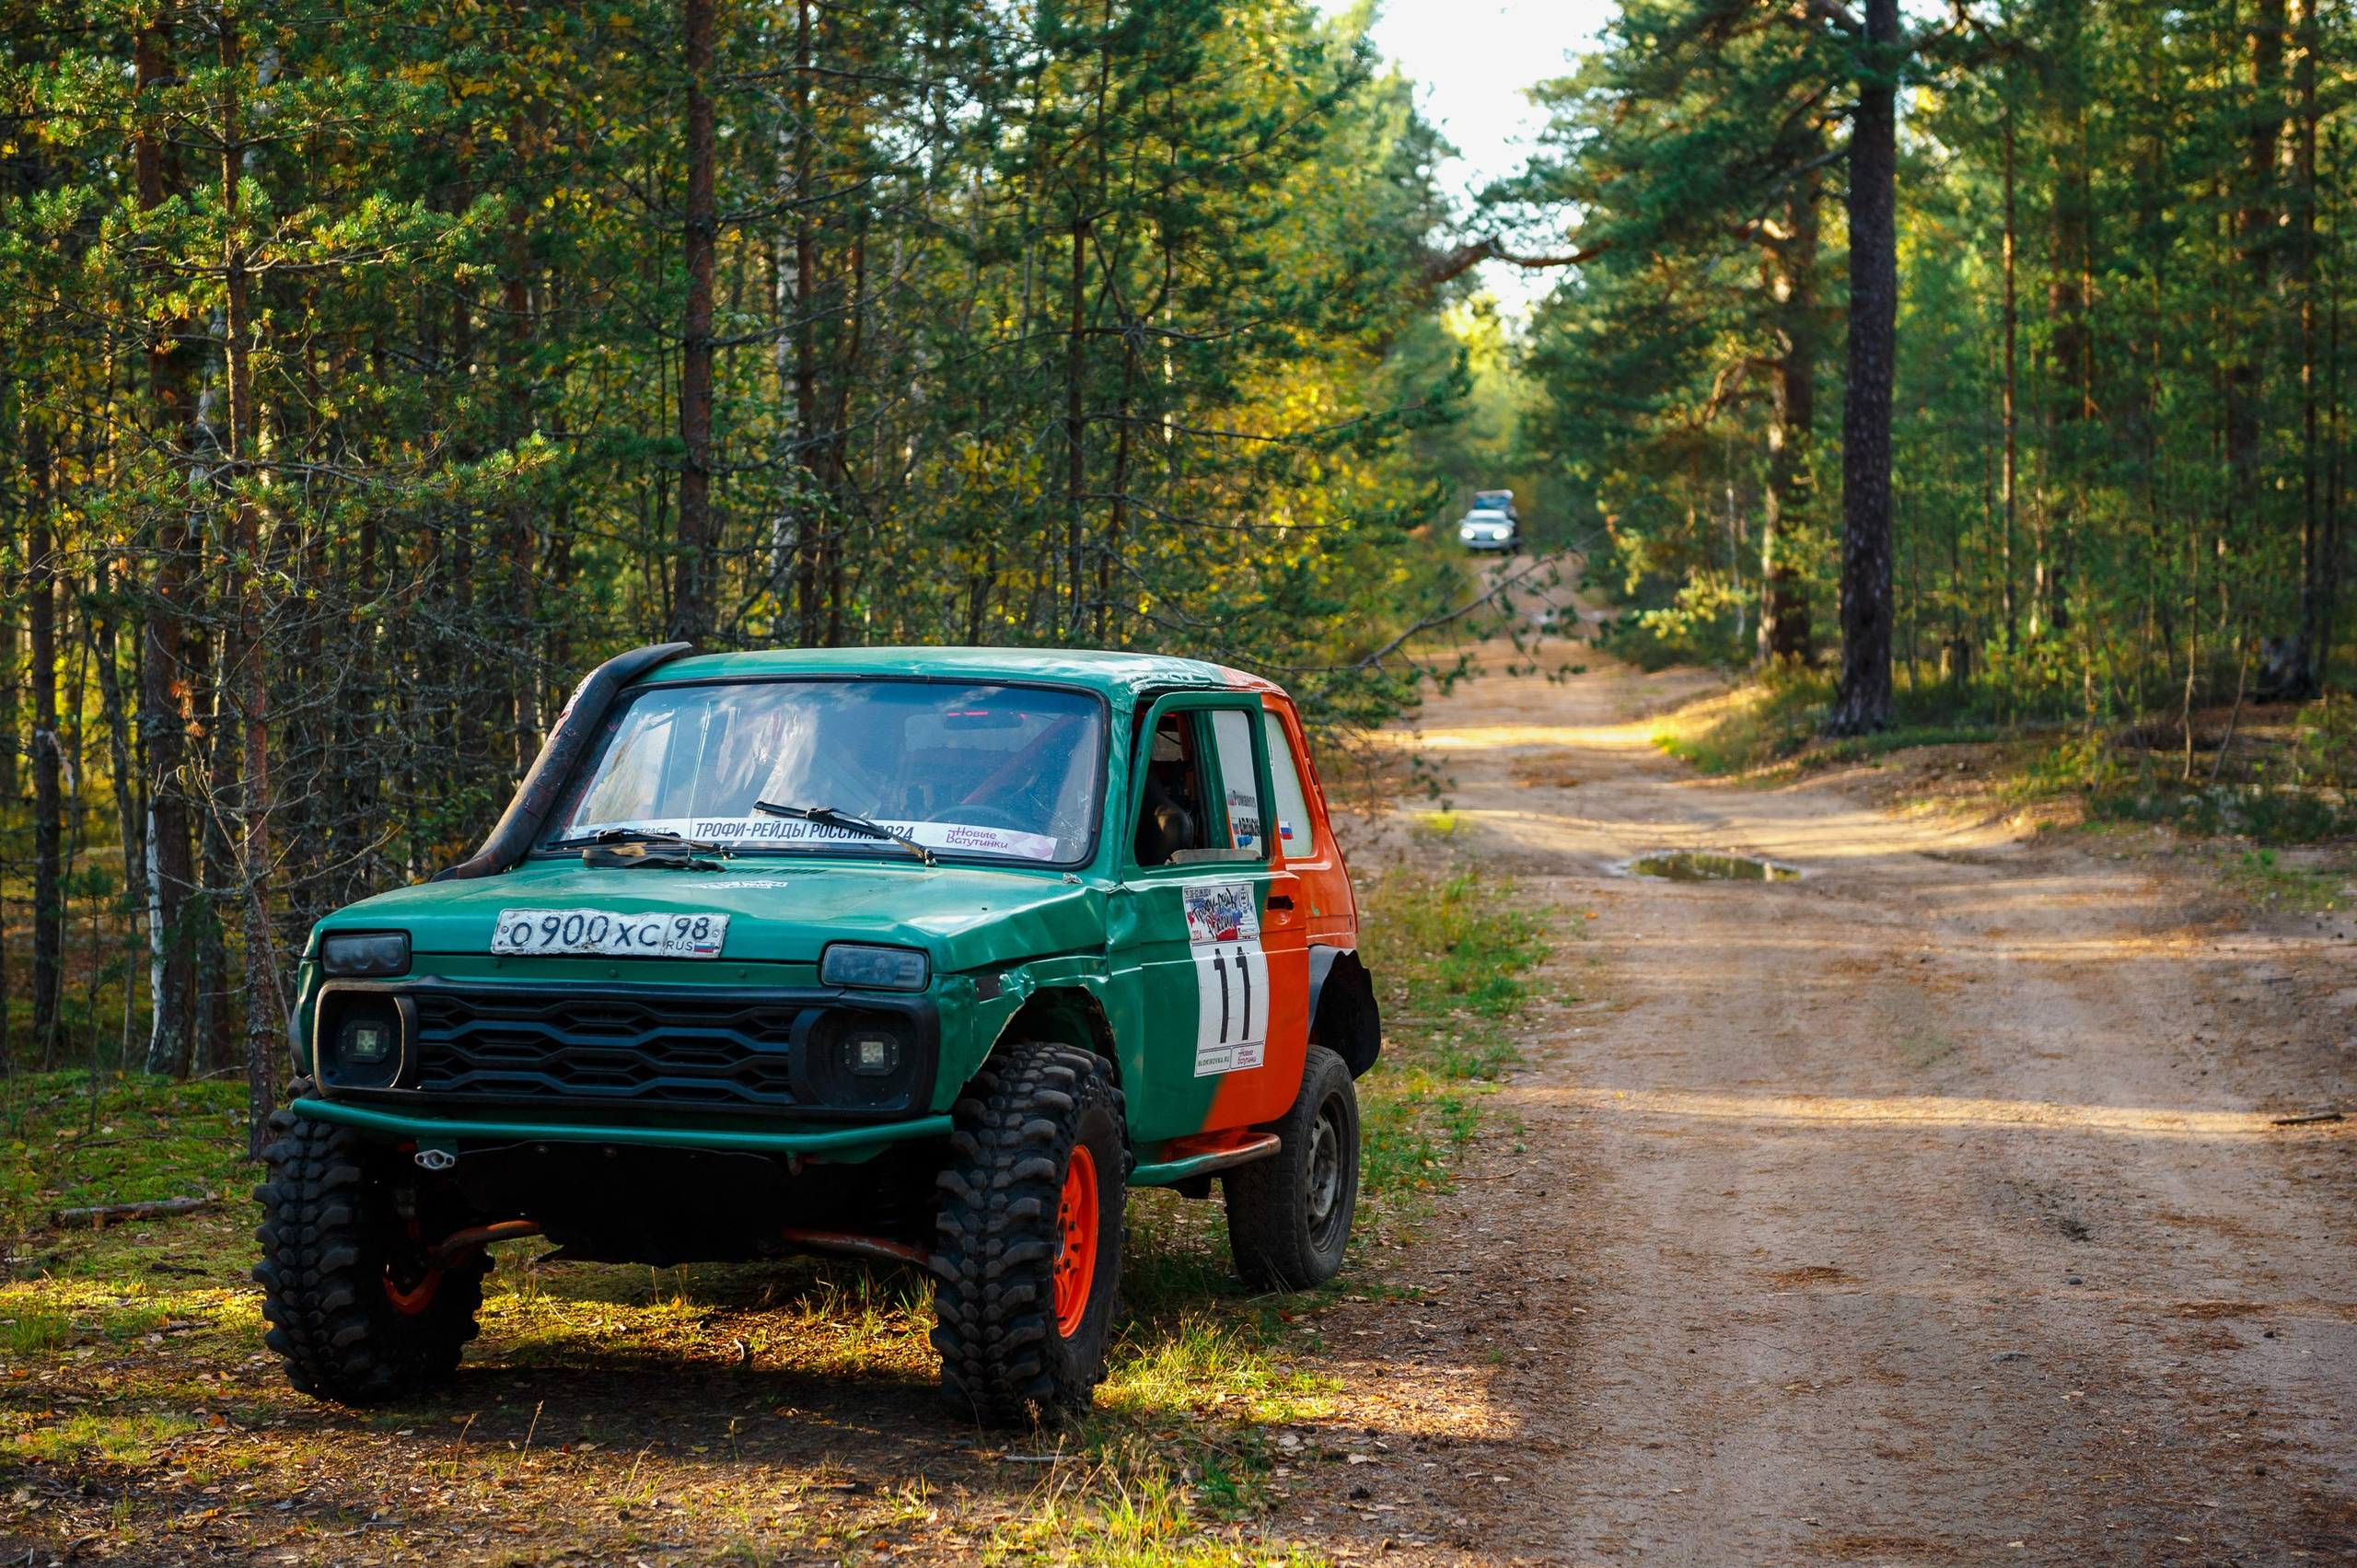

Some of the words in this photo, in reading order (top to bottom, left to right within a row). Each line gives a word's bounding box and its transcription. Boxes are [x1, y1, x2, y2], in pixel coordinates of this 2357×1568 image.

[695, 820, 807, 839] ТРОФИ-РЕЙДЫ
[948, 827, 997, 840] Новые
[946, 832, 1008, 849] Ватутинки
[675, 917, 710, 940] 98
[666, 940, 693, 951] RUS
[1213, 947, 1251, 1044] 11
[1198, 1056, 1230, 1067] BLOKIROVKA.RU
